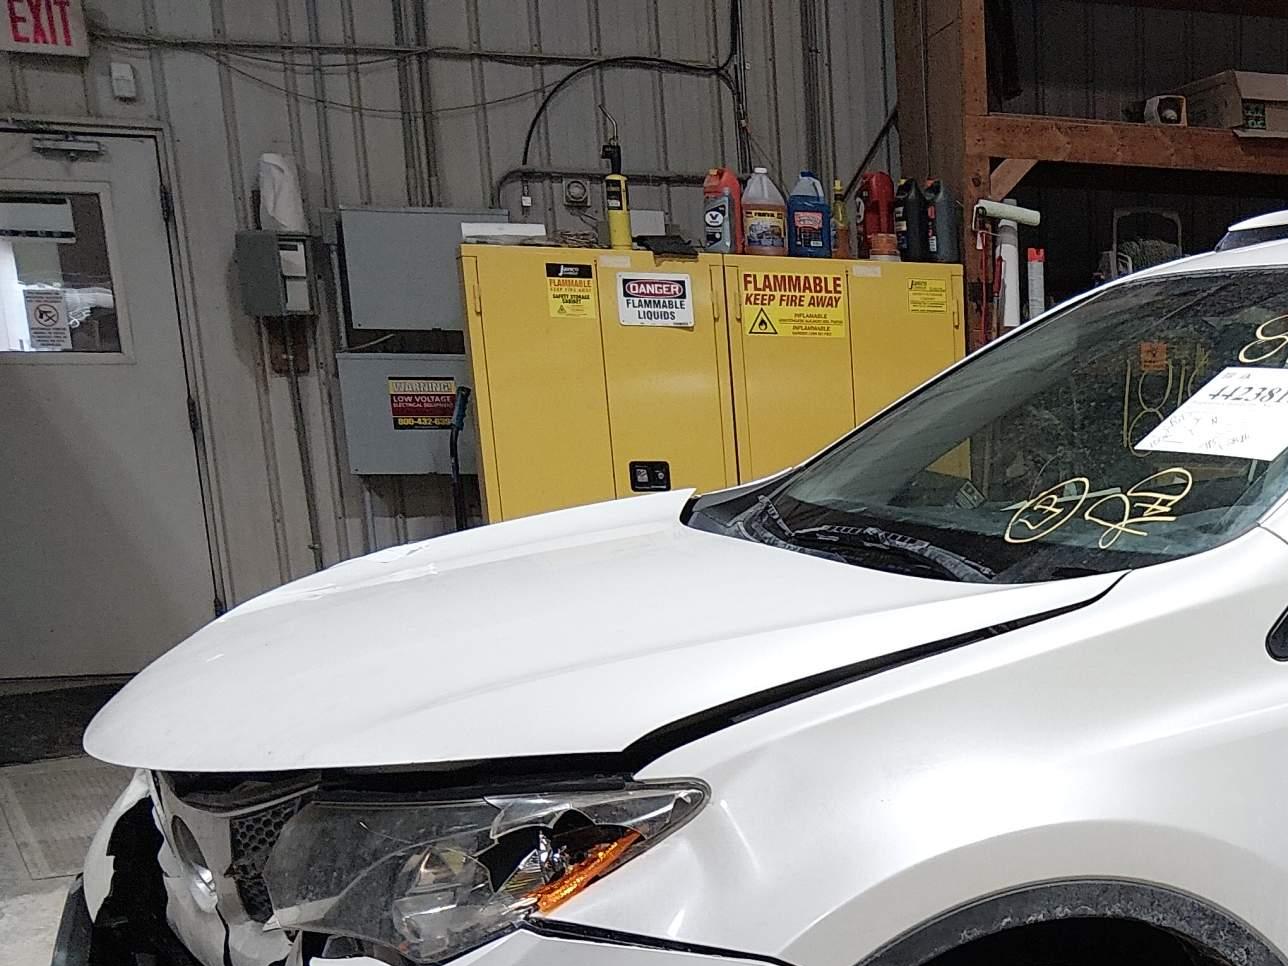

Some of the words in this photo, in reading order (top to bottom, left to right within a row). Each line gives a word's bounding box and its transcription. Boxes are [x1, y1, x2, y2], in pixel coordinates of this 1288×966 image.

[8, 0, 73, 46] EXIT
[549, 279, 592, 287] FLAMMABLE
[743, 273, 842, 295] FLAMMABLE
[629, 283, 680, 295] DANGER
[626, 299, 686, 310] FLAMMABLE
[745, 293, 776, 306] KEEP
[779, 294, 806, 307] FIRE
[807, 295, 841, 308] AWAY
[638, 310, 676, 321] LIQUIDS
[393, 382, 452, 392] WARNING!
[393, 395, 413, 403] LOW
[415, 395, 452, 403] VOLTAGE
